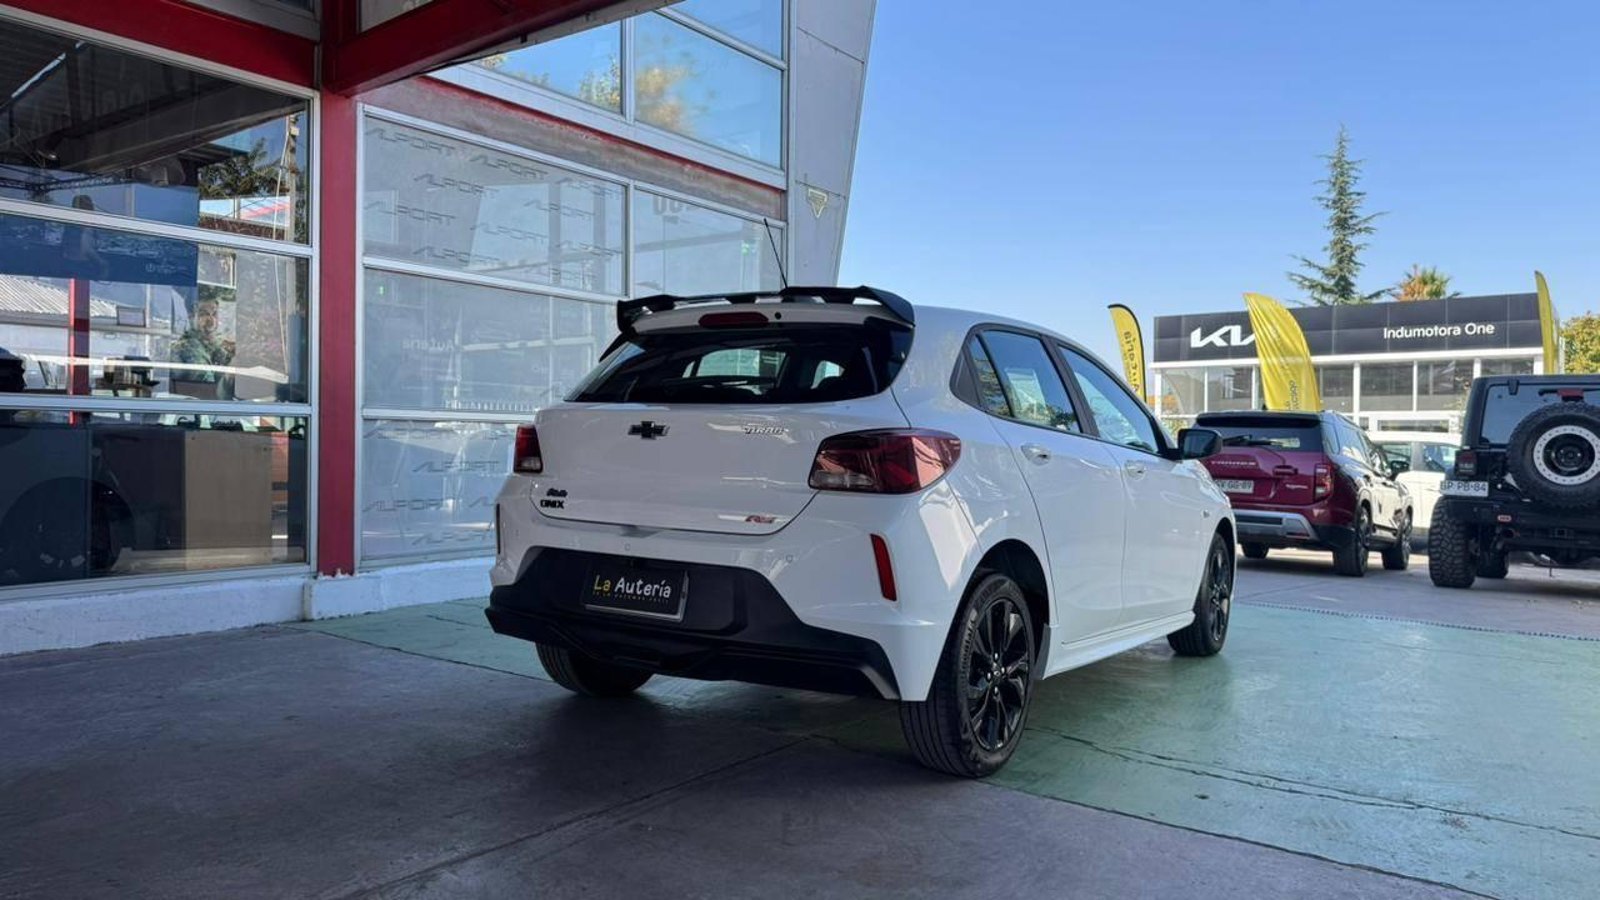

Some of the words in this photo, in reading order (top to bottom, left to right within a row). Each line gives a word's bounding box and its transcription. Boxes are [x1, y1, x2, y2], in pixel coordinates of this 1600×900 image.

[1383, 324, 1462, 340] Indumotora
[1464, 322, 1496, 336] One
[593, 574, 612, 592] La
[614, 576, 672, 599] Autería
